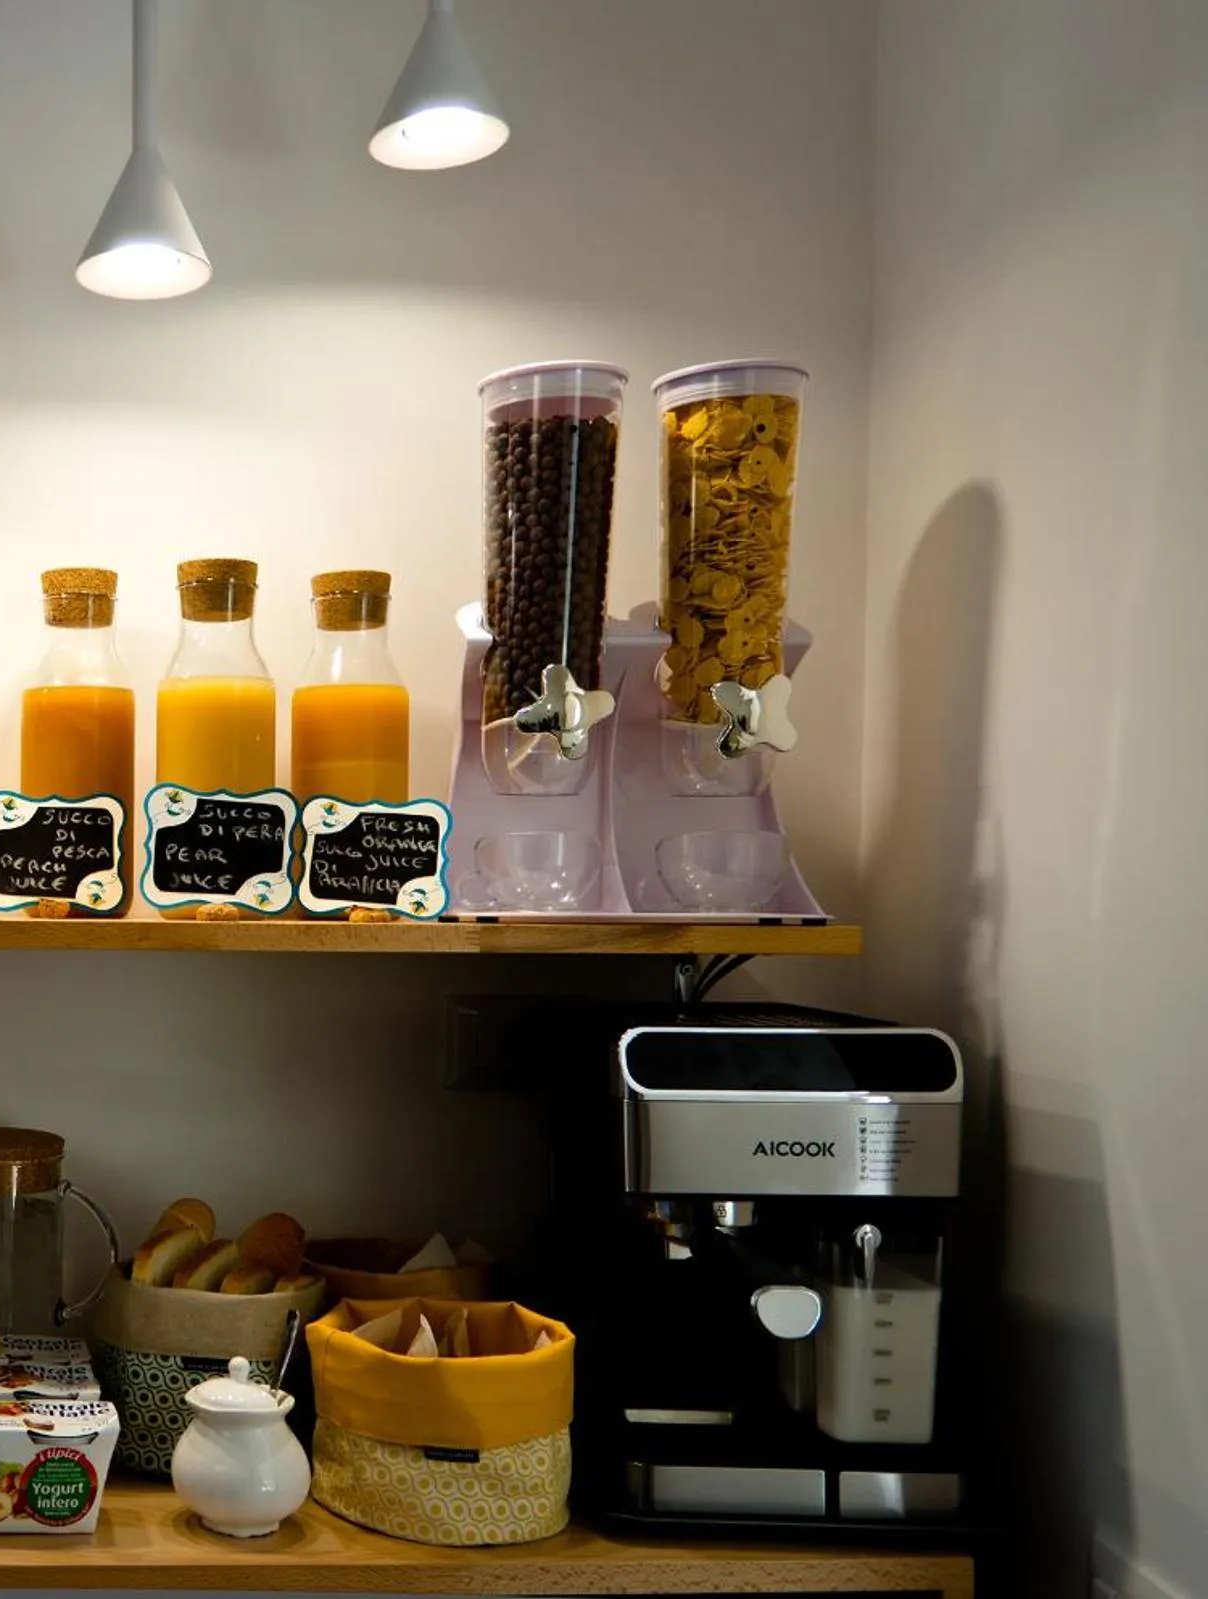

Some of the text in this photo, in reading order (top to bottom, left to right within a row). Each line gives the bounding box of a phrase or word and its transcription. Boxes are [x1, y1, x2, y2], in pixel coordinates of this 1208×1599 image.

[42, 809, 111, 826] SUCCO
[199, 804, 272, 820] SUCCO
[199, 824, 284, 842] DI PERA
[360, 815, 431, 834] FRESH
[55, 829, 76, 842] DI
[52, 844, 110, 860] PESCA
[165, 843, 228, 864] PEAR
[0, 853, 67, 874] PEACH
[313, 859, 337, 874] DI
[365, 853, 429, 871] JUICE
[752, 1141, 836, 1158] AICOOK
[32, 1482, 84, 1497] Yogurt
[37, 1495, 79, 1508] intero
